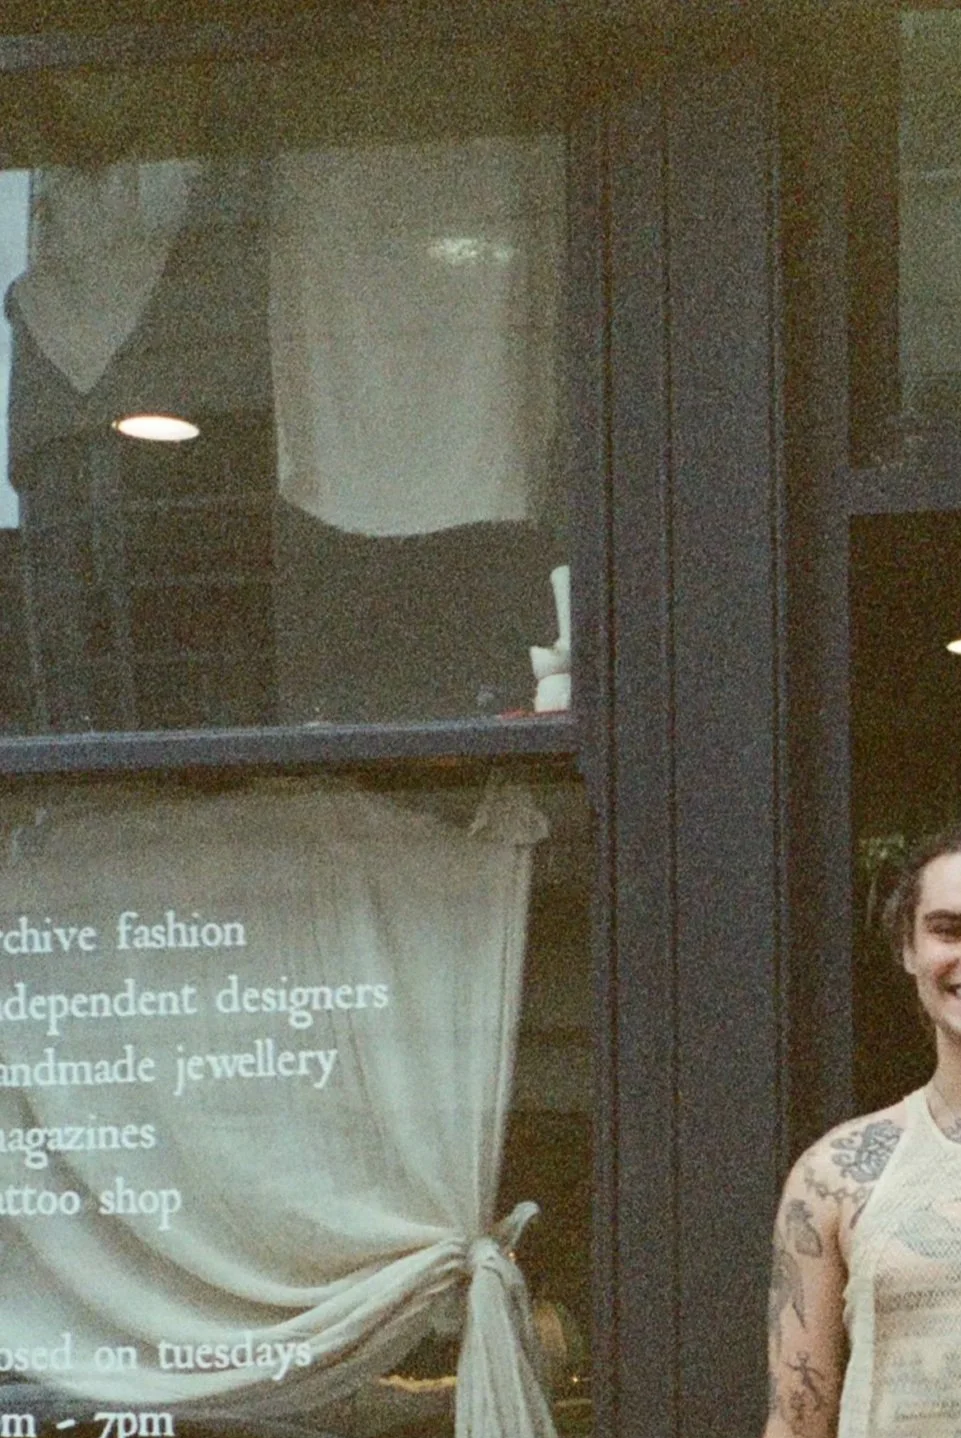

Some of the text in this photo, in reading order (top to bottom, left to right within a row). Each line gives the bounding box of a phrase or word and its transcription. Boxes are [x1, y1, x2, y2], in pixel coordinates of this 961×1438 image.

[0, 910, 247, 954] chive fashion
[0, 974, 389, 1036] dependent designers
[174, 1039, 337, 1096] jewellery
[0, 1115, 156, 1169] agazines
[0, 1177, 182, 1231] ttoo shop
[95, 1346, 137, 1370] on
[158, 1331, 313, 1381] tuesdays
